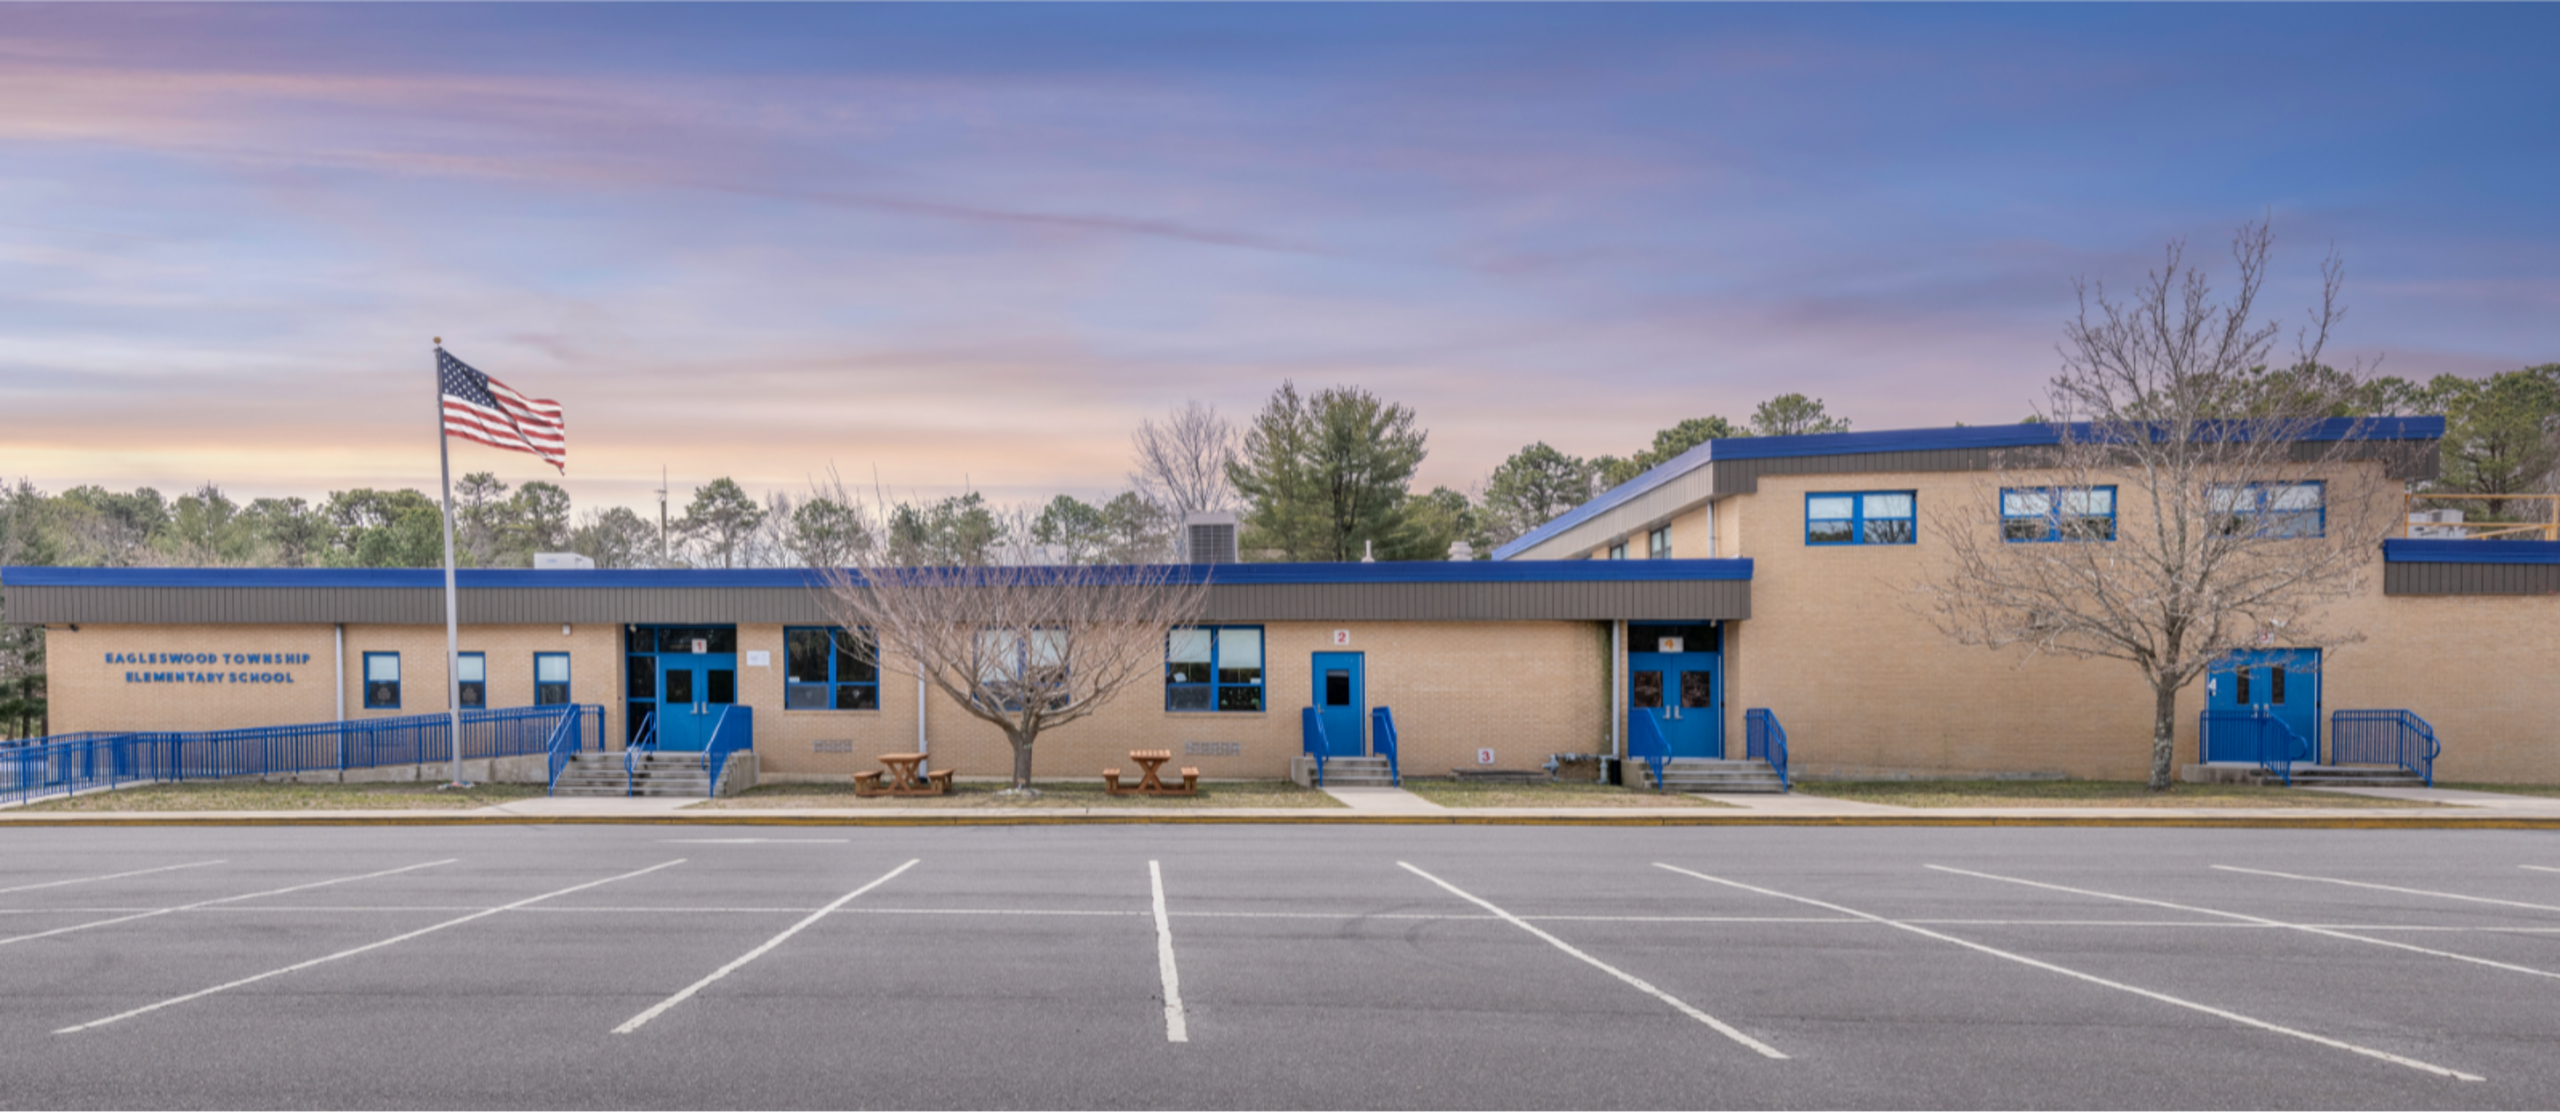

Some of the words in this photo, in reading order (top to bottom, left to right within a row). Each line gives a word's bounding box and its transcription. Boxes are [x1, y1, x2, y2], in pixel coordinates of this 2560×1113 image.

[1337, 631, 1346, 643] 2
[105, 653, 217, 664] EAGLESWOOD
[223, 653, 310, 664] TOWNSHIP
[126, 672, 224, 683] ELEMENTARY
[229, 672, 294, 683] SCHOOL
[1482, 750, 1491, 762] 3
